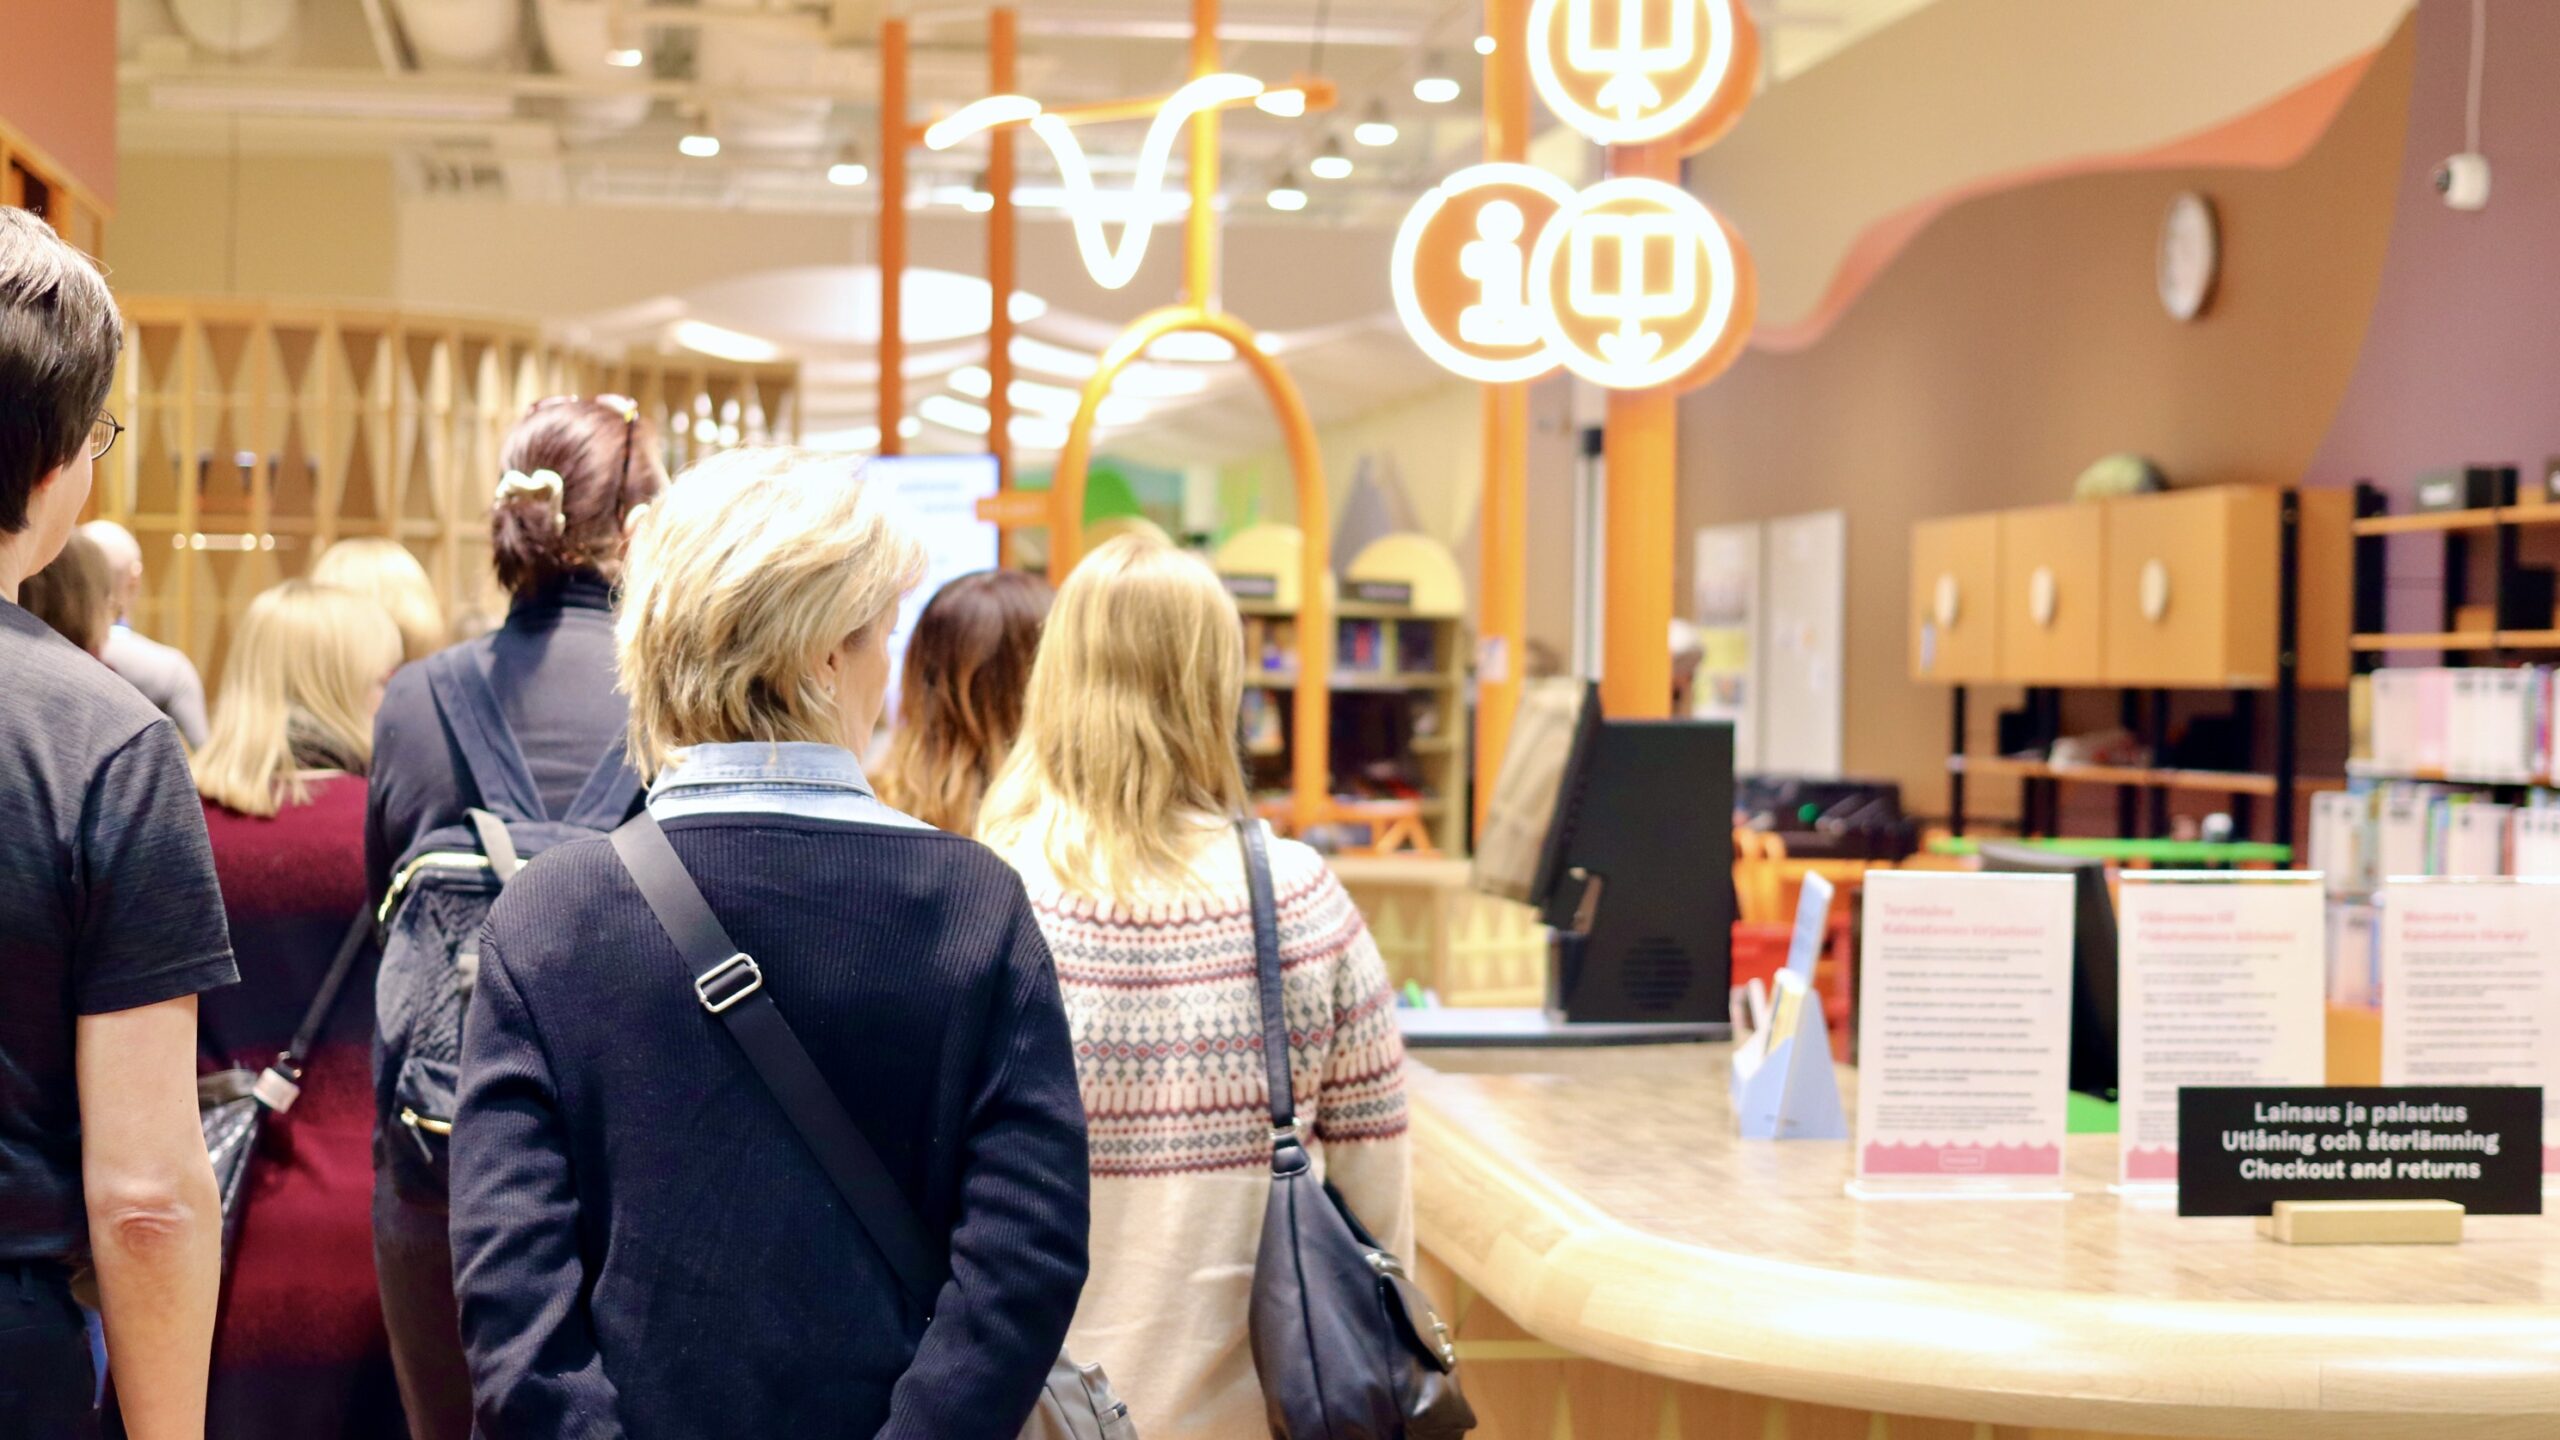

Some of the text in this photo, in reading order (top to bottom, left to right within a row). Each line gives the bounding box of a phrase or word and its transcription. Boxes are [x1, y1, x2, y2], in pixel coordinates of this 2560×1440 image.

[2254, 1101, 2468, 1127] Lainaus ja palautus
[2222, 1129, 2500, 1156] Utlåning och återlämning
[2239, 1158, 2482, 1180] Checkout and returns
